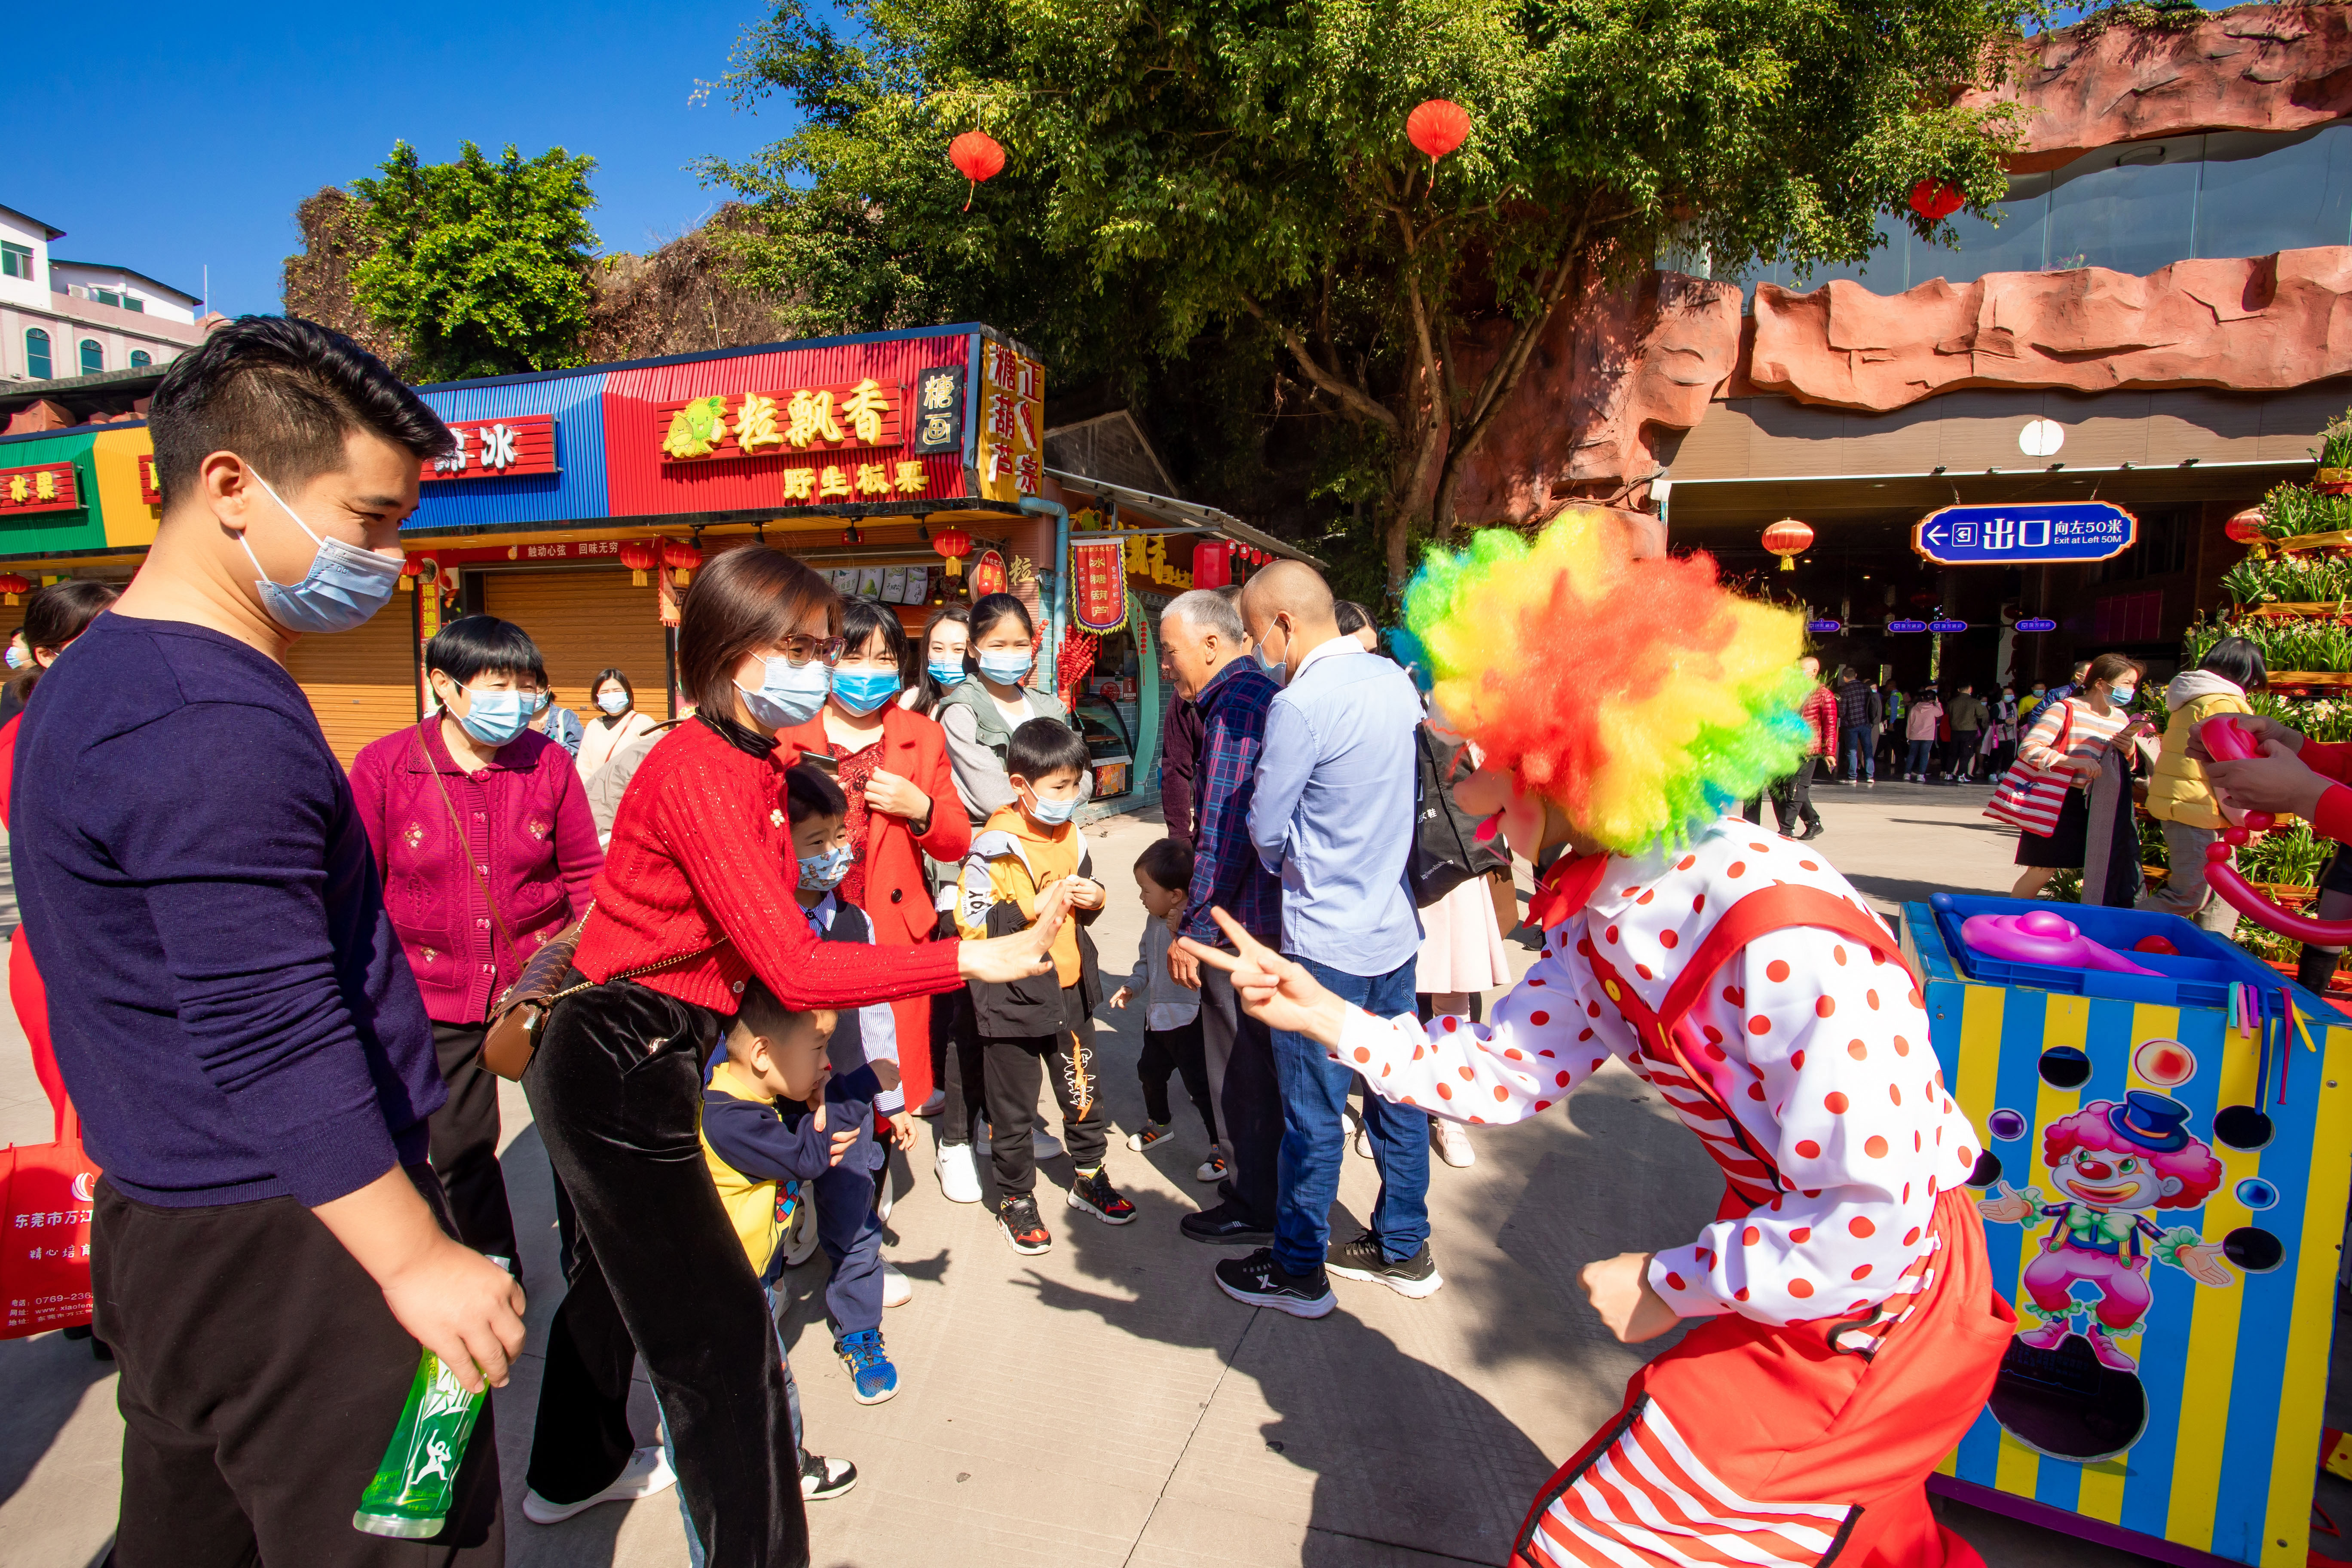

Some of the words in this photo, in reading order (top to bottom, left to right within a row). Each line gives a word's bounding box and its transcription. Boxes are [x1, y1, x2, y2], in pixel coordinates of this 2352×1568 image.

[732, 377, 889, 454] 粒飘香
[922, 374, 955, 446] 糖画
[989, 345, 1016, 483] 糖葫芦
[10, 471, 55, 502] 水果
[784, 461, 929, 499] 野生板栗
[1983, 518, 2050, 549] 出口
[2054, 535, 2070, 544] Exit
[2082, 535, 2100, 544] Left
[2101, 535, 2122, 543] 50M
[2055, 519, 2122, 535] 向左50米
[528, 545, 567, 557] 触动心弦
[579, 542, 618, 554] 回味无穷
[1008, 554, 1034, 586] 粒
[1089, 557, 1110, 617] 冰糖葫芦
[30, 1243, 91, 1260] 精心培育
